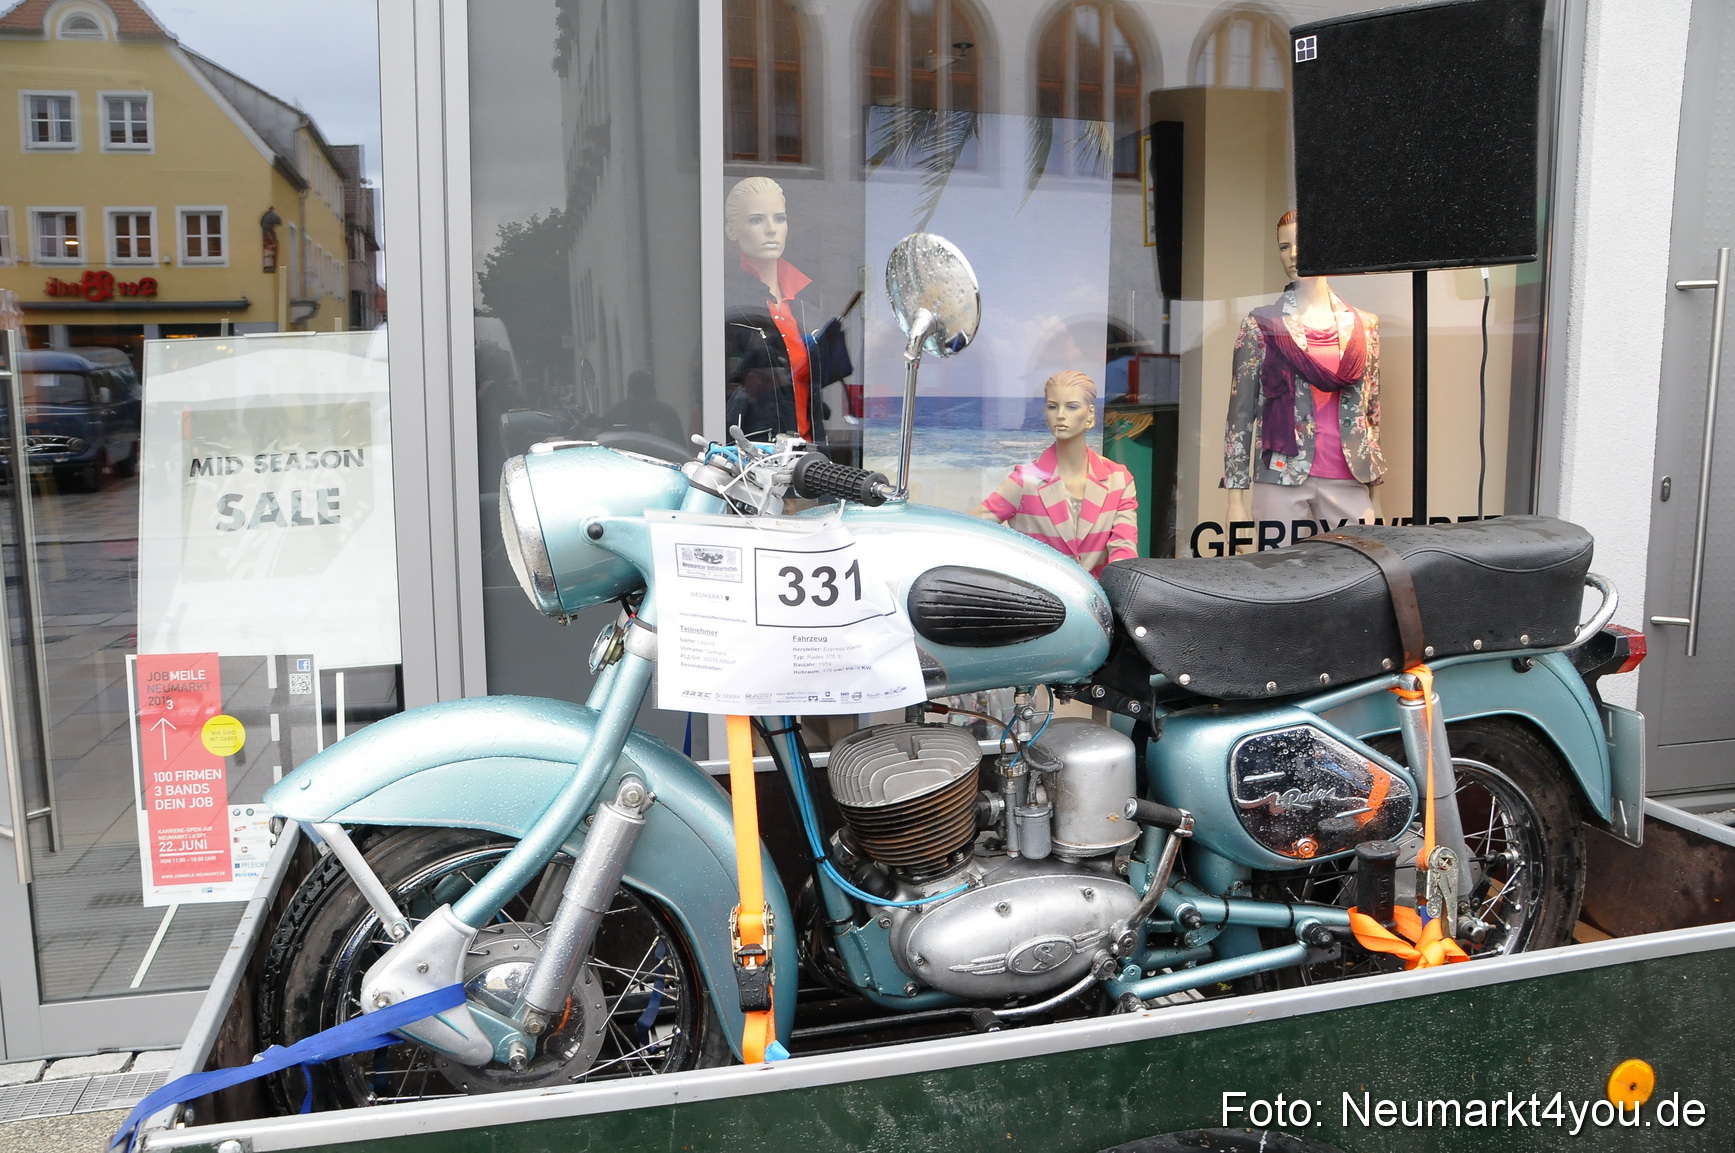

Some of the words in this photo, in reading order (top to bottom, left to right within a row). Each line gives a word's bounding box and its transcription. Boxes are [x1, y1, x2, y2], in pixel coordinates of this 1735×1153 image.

[189, 456, 244, 478] MID
[254, 448, 364, 474] SEASON
[216, 488, 340, 532] SALE
[778, 558, 862, 606] 331
[691, 592, 723, 600] NEUMARKT
[680, 625, 718, 636] Teilnehmer
[146, 670, 206, 681] JOBMEILE
[146, 682, 211, 693] NEUMARKT
[154, 772, 172, 782] 100
[175, 769, 222, 781] FIRMEN
[154, 785, 162, 796] 3
[165, 783, 210, 796] BANDS
[155, 798, 186, 810] DEIN
[189, 797, 214, 808] JOB
[159, 842, 176, 852] 22.
[179, 839, 208, 851] JUNI
